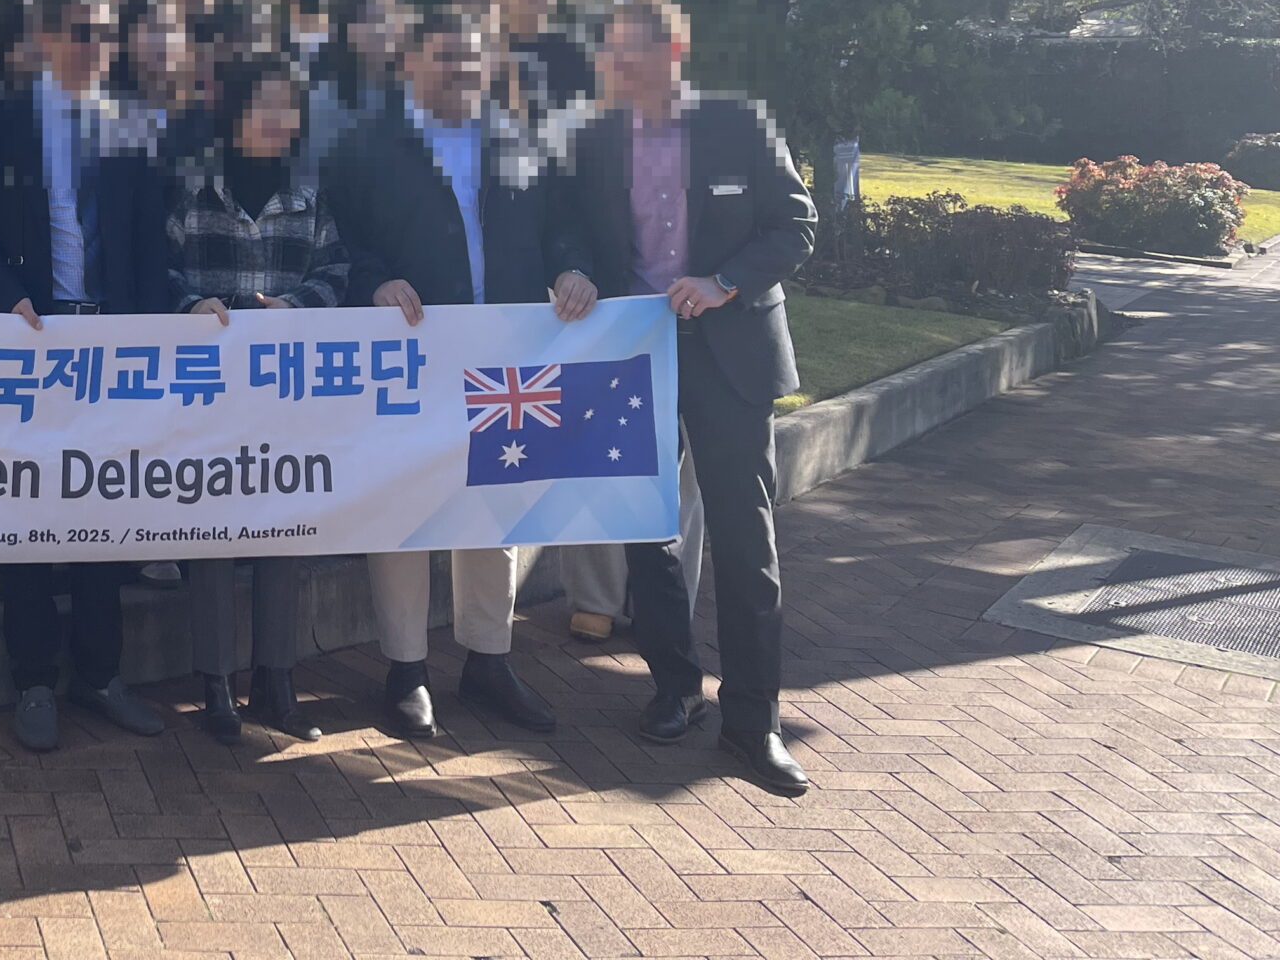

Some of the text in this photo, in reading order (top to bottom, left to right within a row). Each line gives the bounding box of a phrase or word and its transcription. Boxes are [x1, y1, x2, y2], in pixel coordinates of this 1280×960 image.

[250, 339, 426, 415] 대표단
[61, 443, 332, 504] Delegation
[29, 529, 60, 544] 8th,
[67, 529, 114, 543] 2025.
[136, 527, 232, 541] Strathfield,
[238, 525, 316, 539] Australia
